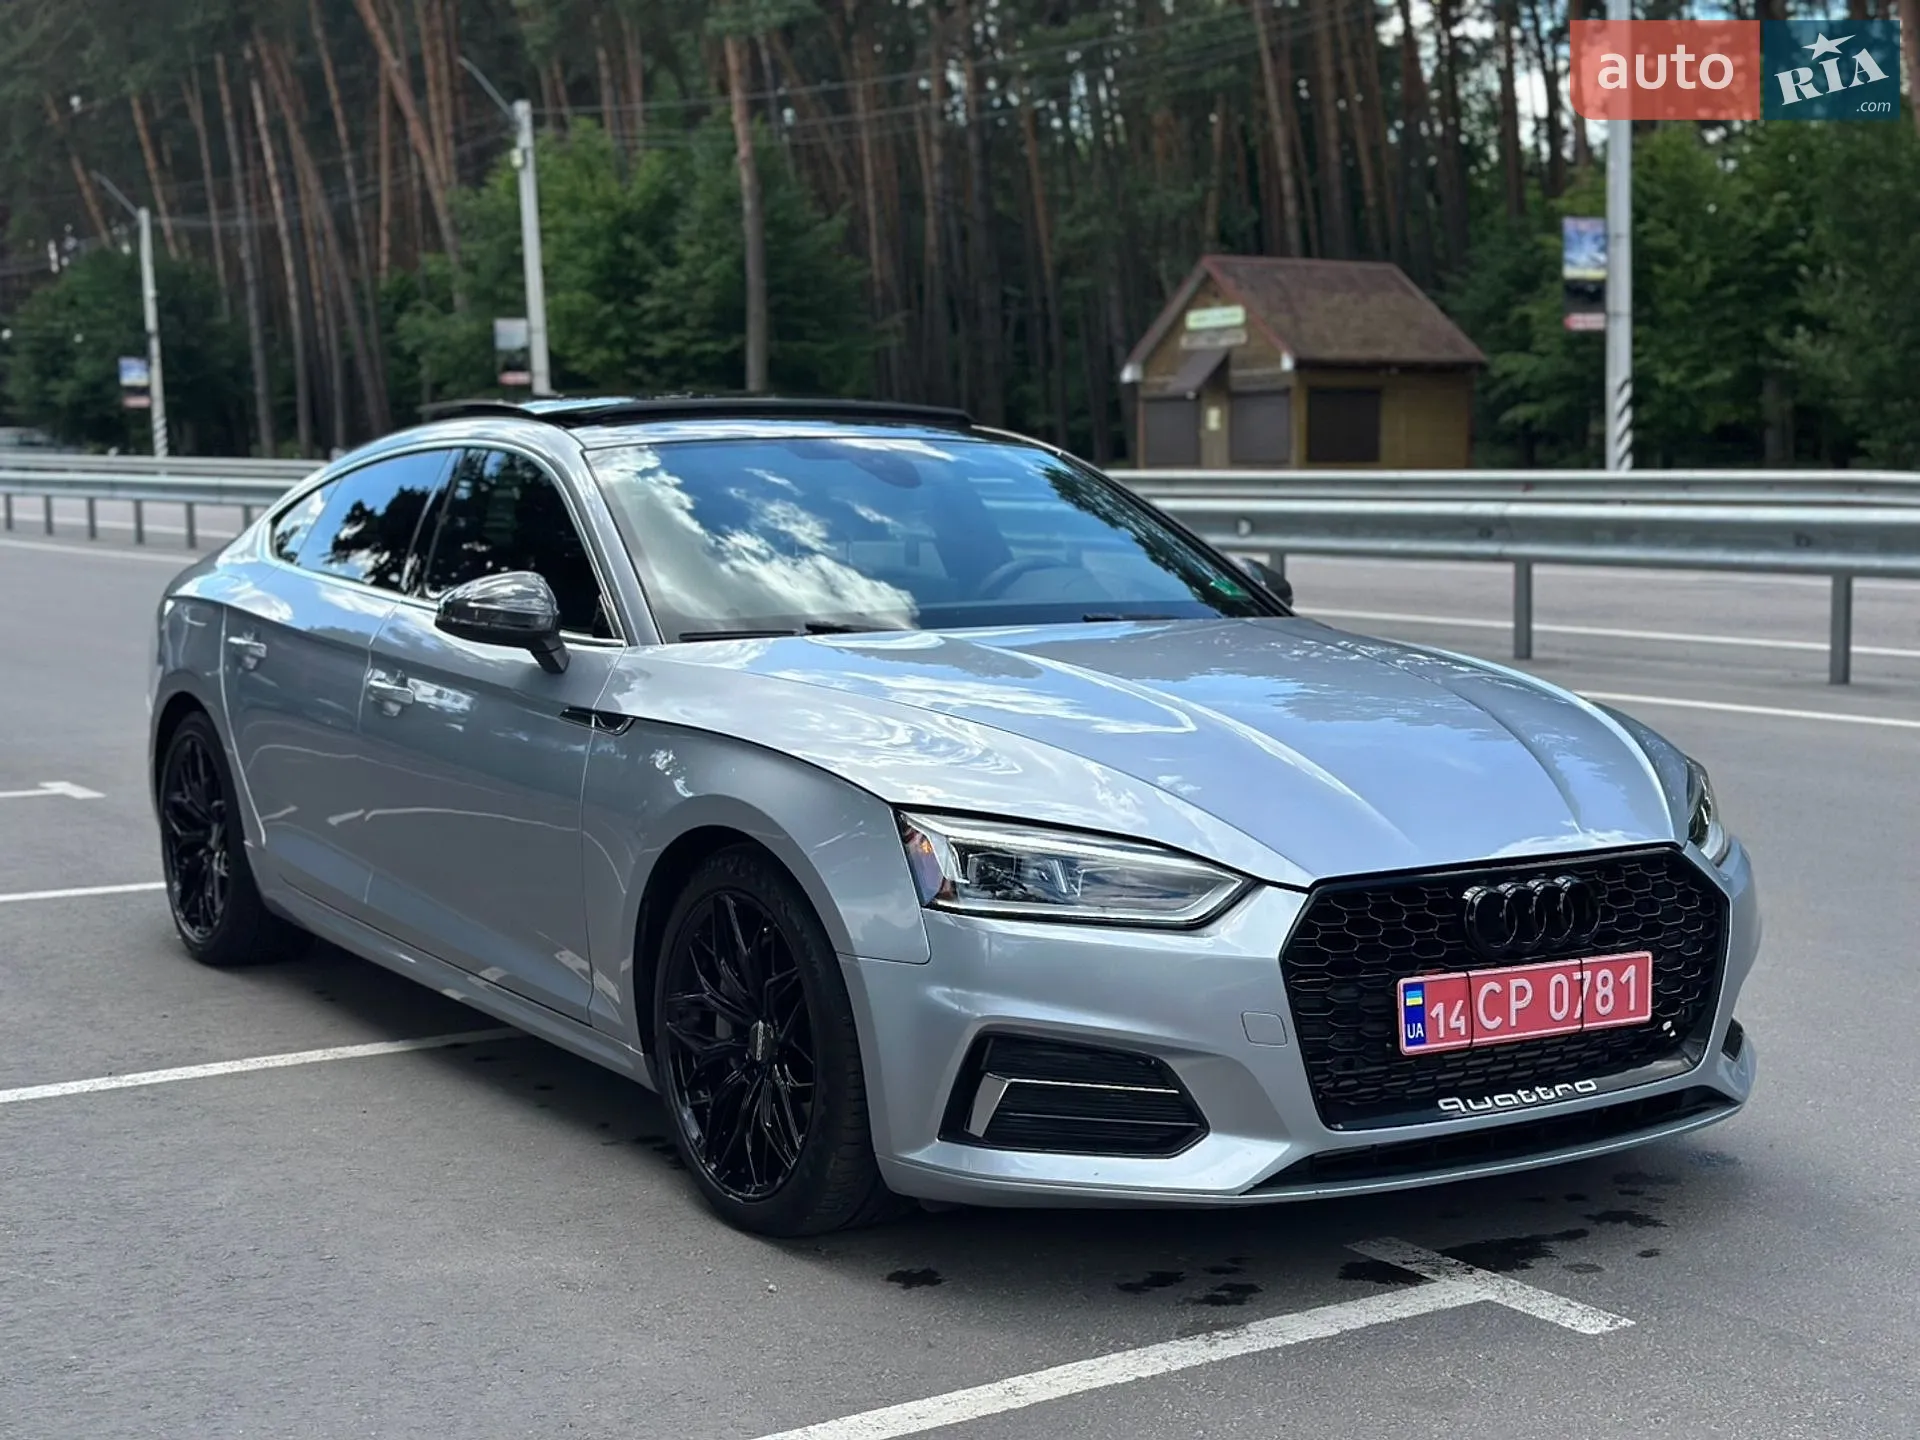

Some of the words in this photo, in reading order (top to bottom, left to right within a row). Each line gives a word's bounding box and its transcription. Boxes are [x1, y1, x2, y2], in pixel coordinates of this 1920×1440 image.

[1430, 999, 1466, 1038] 14
[1477, 979, 1533, 1030] CP
[1550, 964, 1636, 1021] 0781
[1407, 1022, 1424, 1039] UA
[1437, 1079, 1597, 1113] quattro
